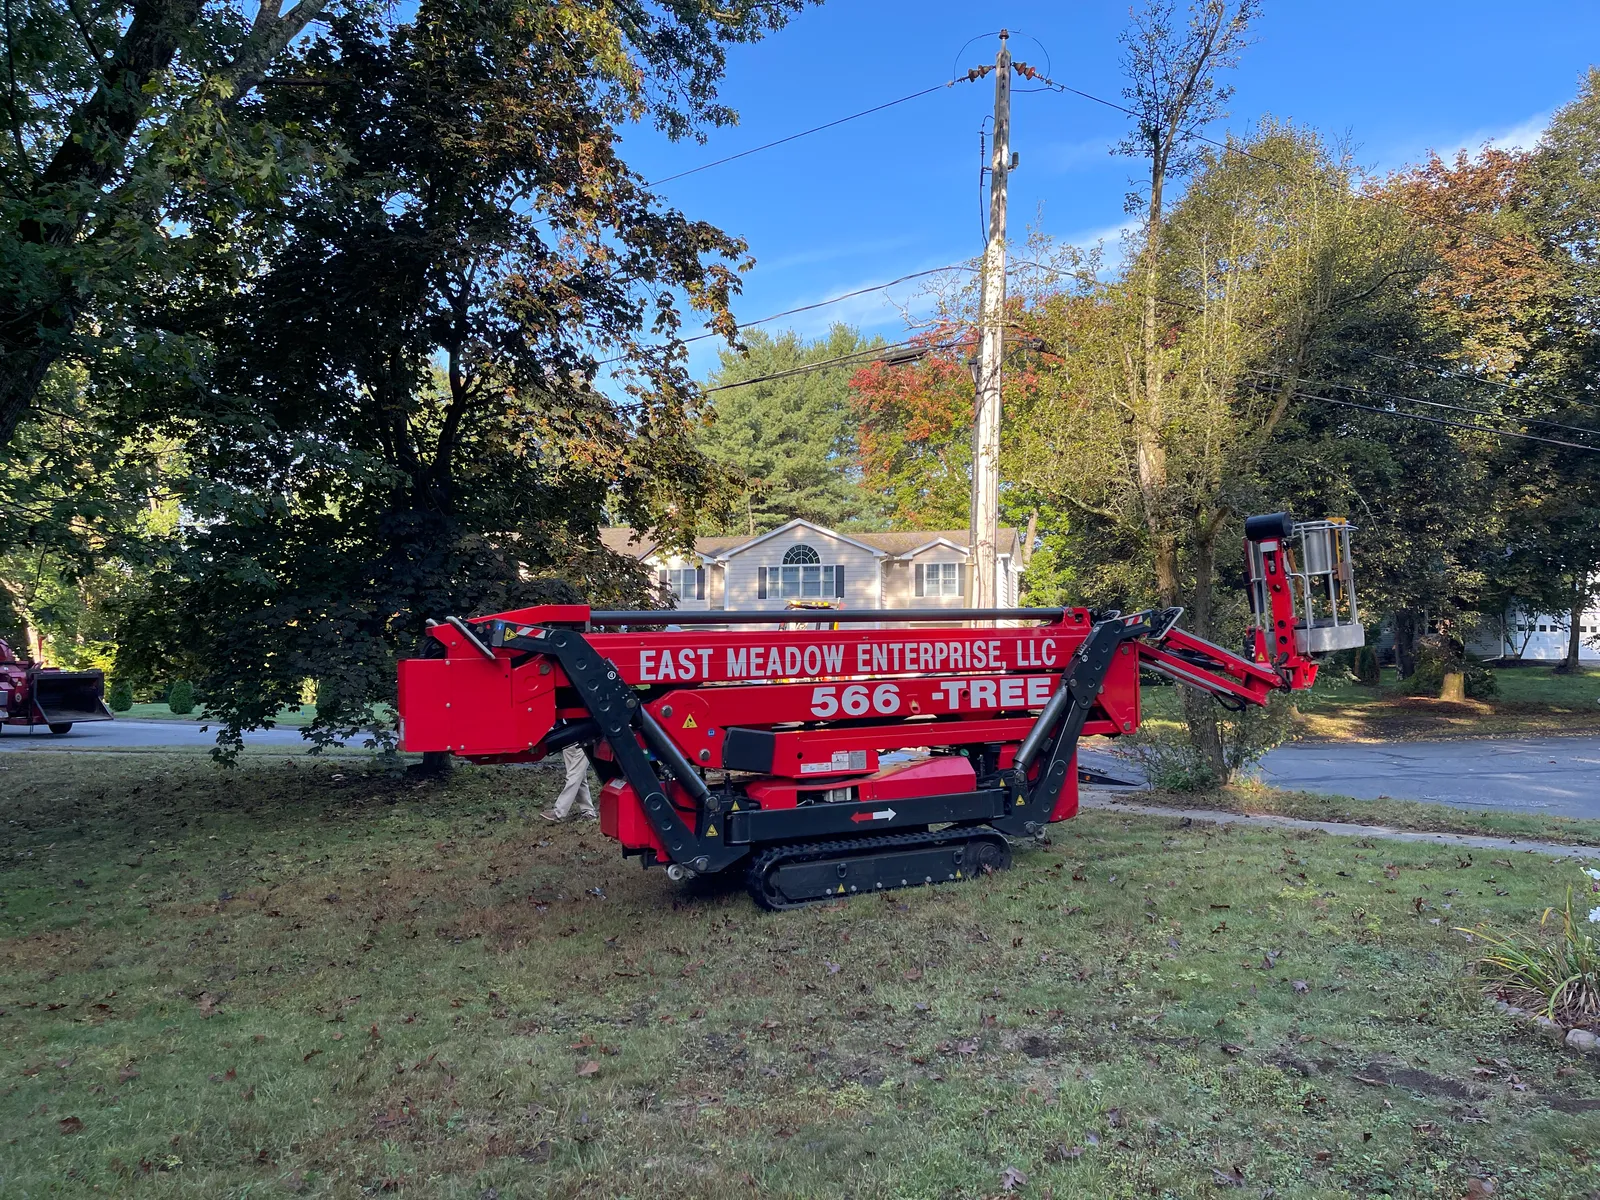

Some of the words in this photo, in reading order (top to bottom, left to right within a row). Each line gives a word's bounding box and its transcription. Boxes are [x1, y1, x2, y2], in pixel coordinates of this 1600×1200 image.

[640, 648, 713, 681] EAST
[727, 644, 844, 677] MEADOW
[857, 640, 1006, 672] ENTERPRISE,
[1016, 638, 1056, 666] LLC
[810, 683, 900, 717] 566
[932, 677, 1051, 710] -TREE
